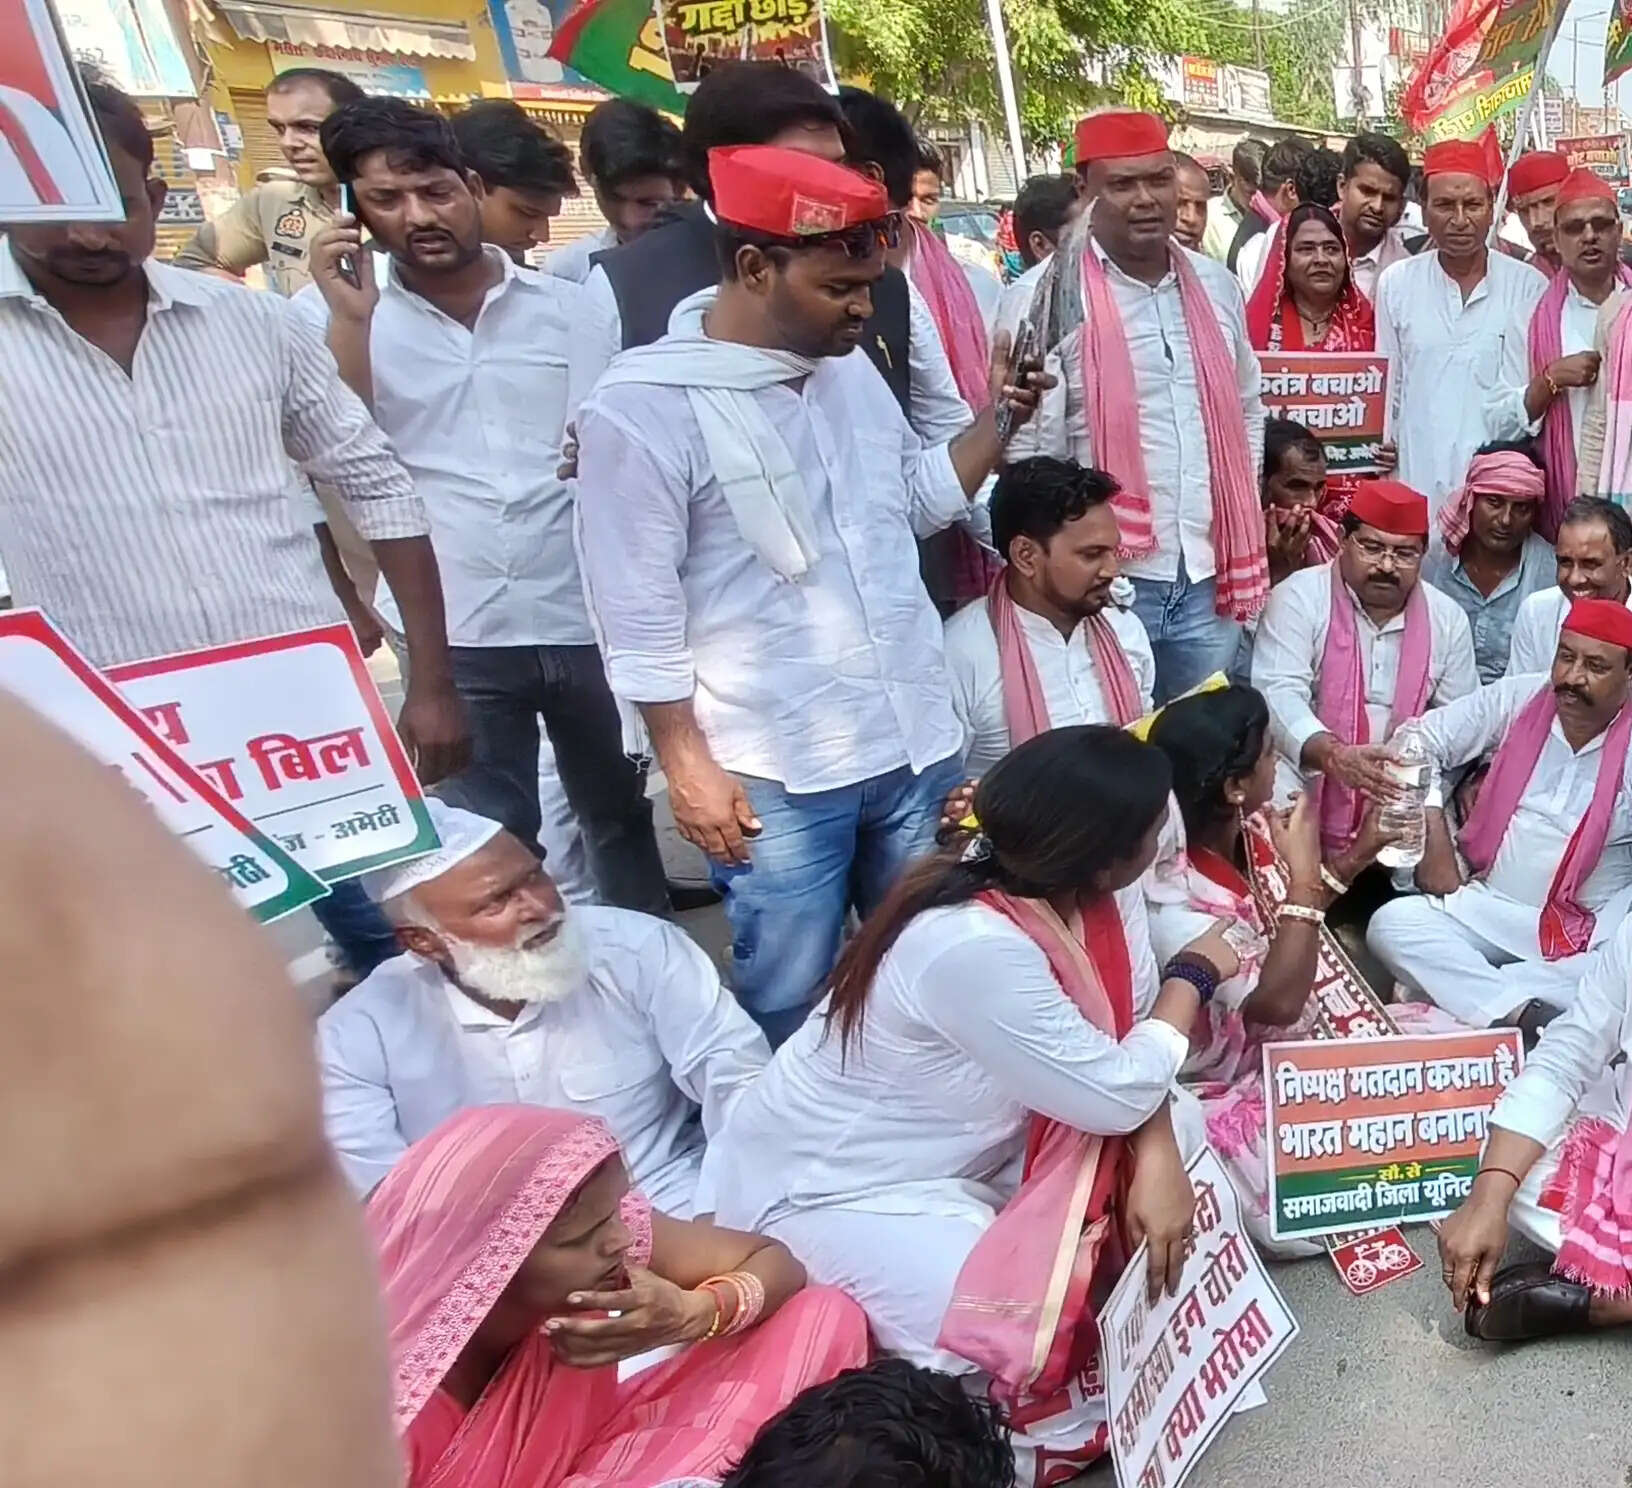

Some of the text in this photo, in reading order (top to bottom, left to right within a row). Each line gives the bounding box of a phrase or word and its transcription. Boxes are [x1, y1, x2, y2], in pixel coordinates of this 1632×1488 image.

[1261, 365, 1384, 396] तंत्र बचाओ
[1286, 396, 1366, 428] बचाओ
[245, 726, 372, 791] बिल
[331, 804, 400, 840] अमेठी
[1275, 1042, 1518, 1107] निष्पक्ष मतदान कराना है
[1279, 1120, 1343, 1160] भारत
[1347, 1112, 1415, 1155] महान
[1282, 1172, 1473, 1220] समाजवादी जिला यूनिट
[1167, 1284, 1206, 1357] इन
[1200, 1231, 1249, 1307] चोरो
[1161, 1377, 1206, 1461] क्या
[1199, 1298, 1274, 1401] भरोसा
